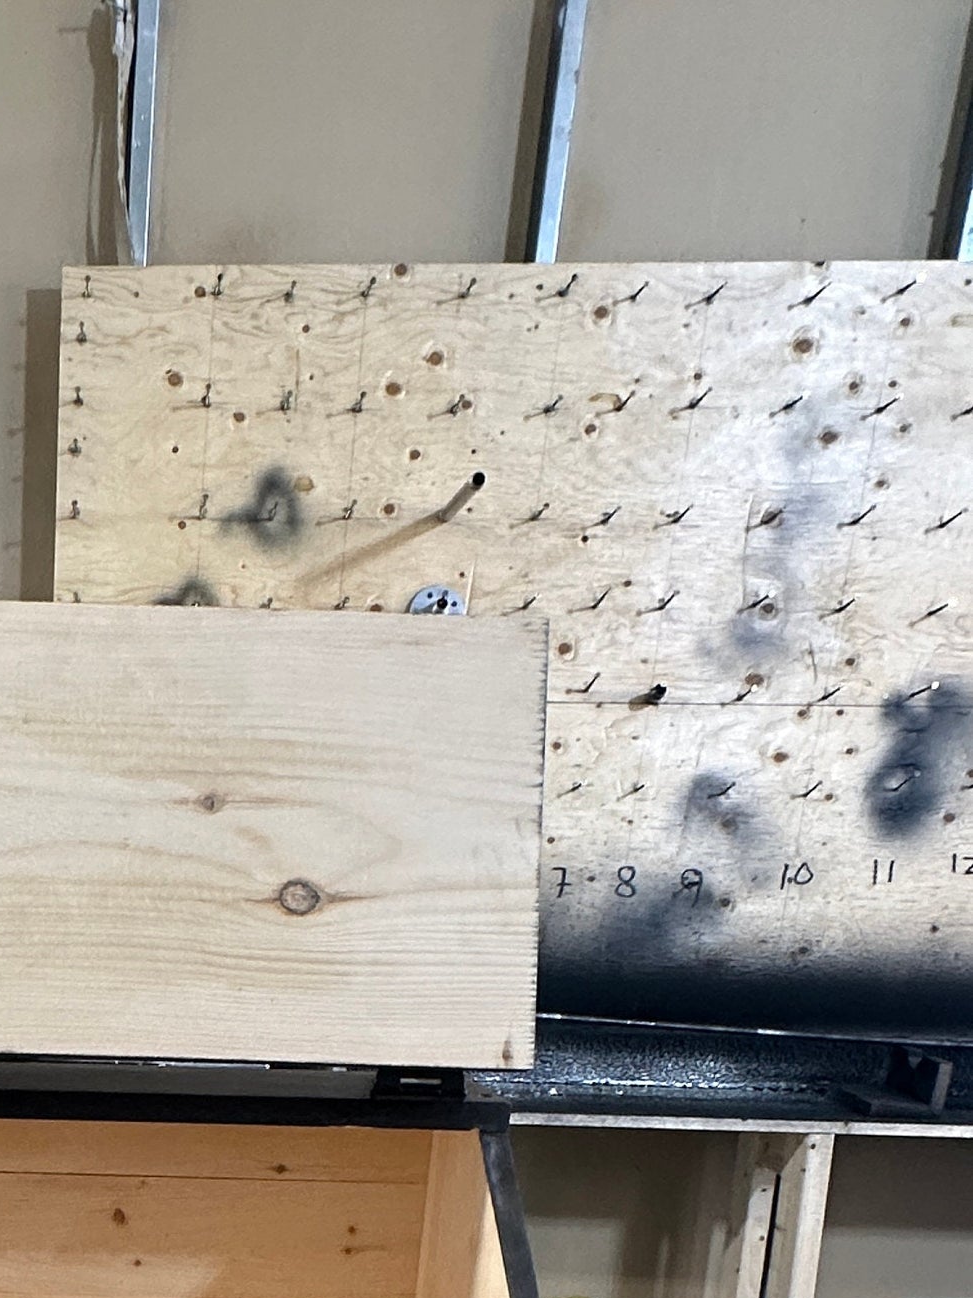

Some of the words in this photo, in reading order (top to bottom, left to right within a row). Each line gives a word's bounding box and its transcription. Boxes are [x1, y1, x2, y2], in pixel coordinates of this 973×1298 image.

[551, 866, 572, 898] 7
[614, 865, 636, 898] 8
[680, 868, 704, 908] 9
[779, 862, 814, 890] 10
[872, 859, 895, 885] 11
